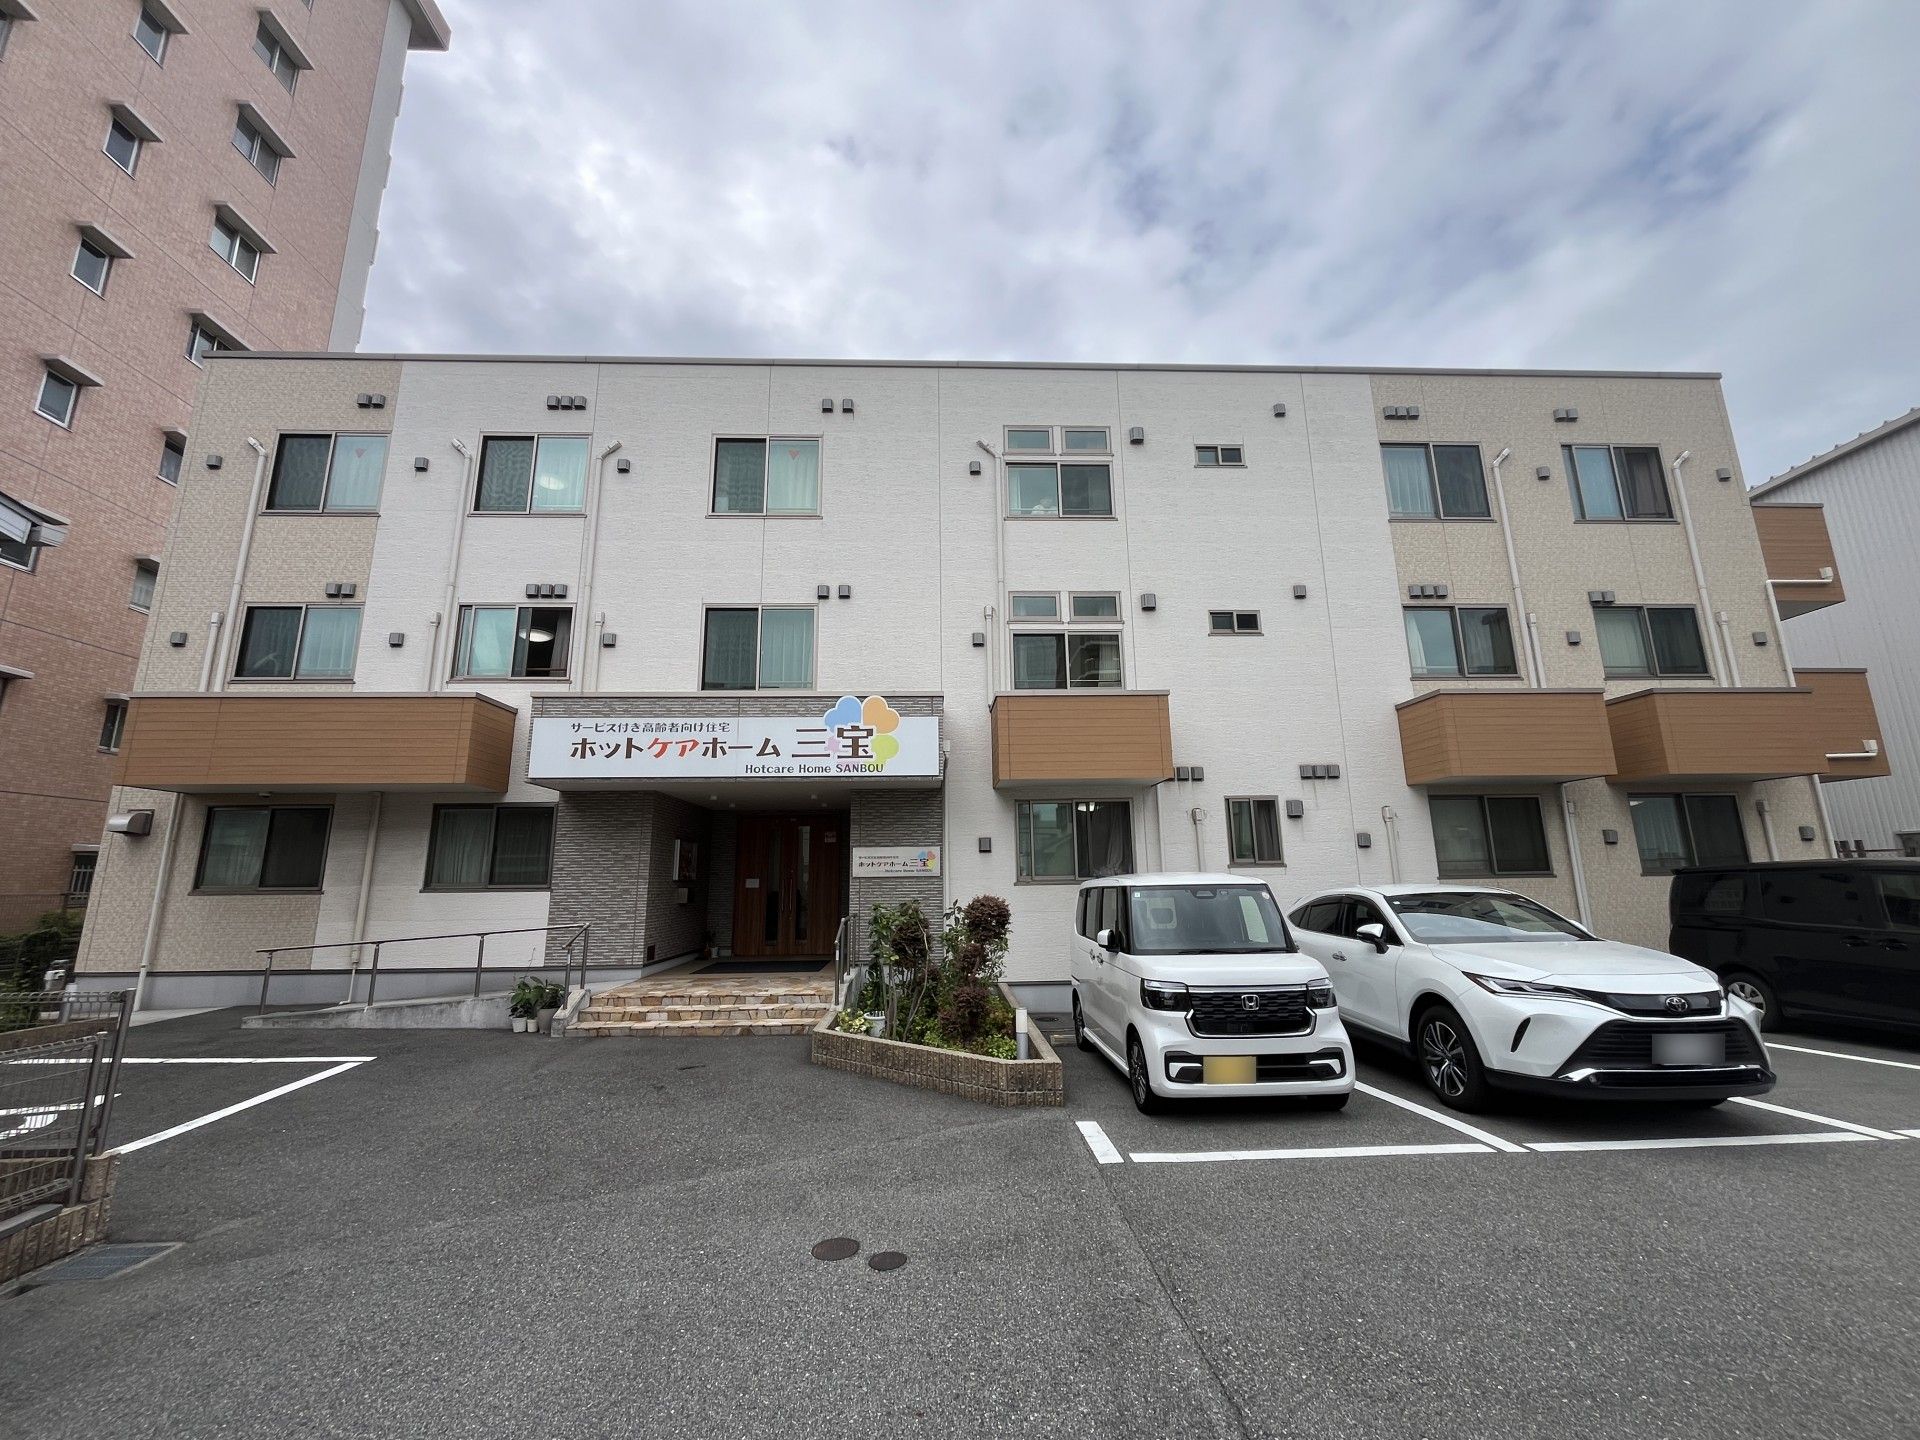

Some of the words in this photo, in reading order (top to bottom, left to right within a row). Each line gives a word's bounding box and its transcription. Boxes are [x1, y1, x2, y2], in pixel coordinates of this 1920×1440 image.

[571, 722, 731, 734] サービス付き高齢者向け住宅
[791, 725, 874, 759] 三宝
[745, 763, 795, 774] Hotcare
[799, 763, 832, 773] Home
[835, 763, 884, 773] SANBOU
